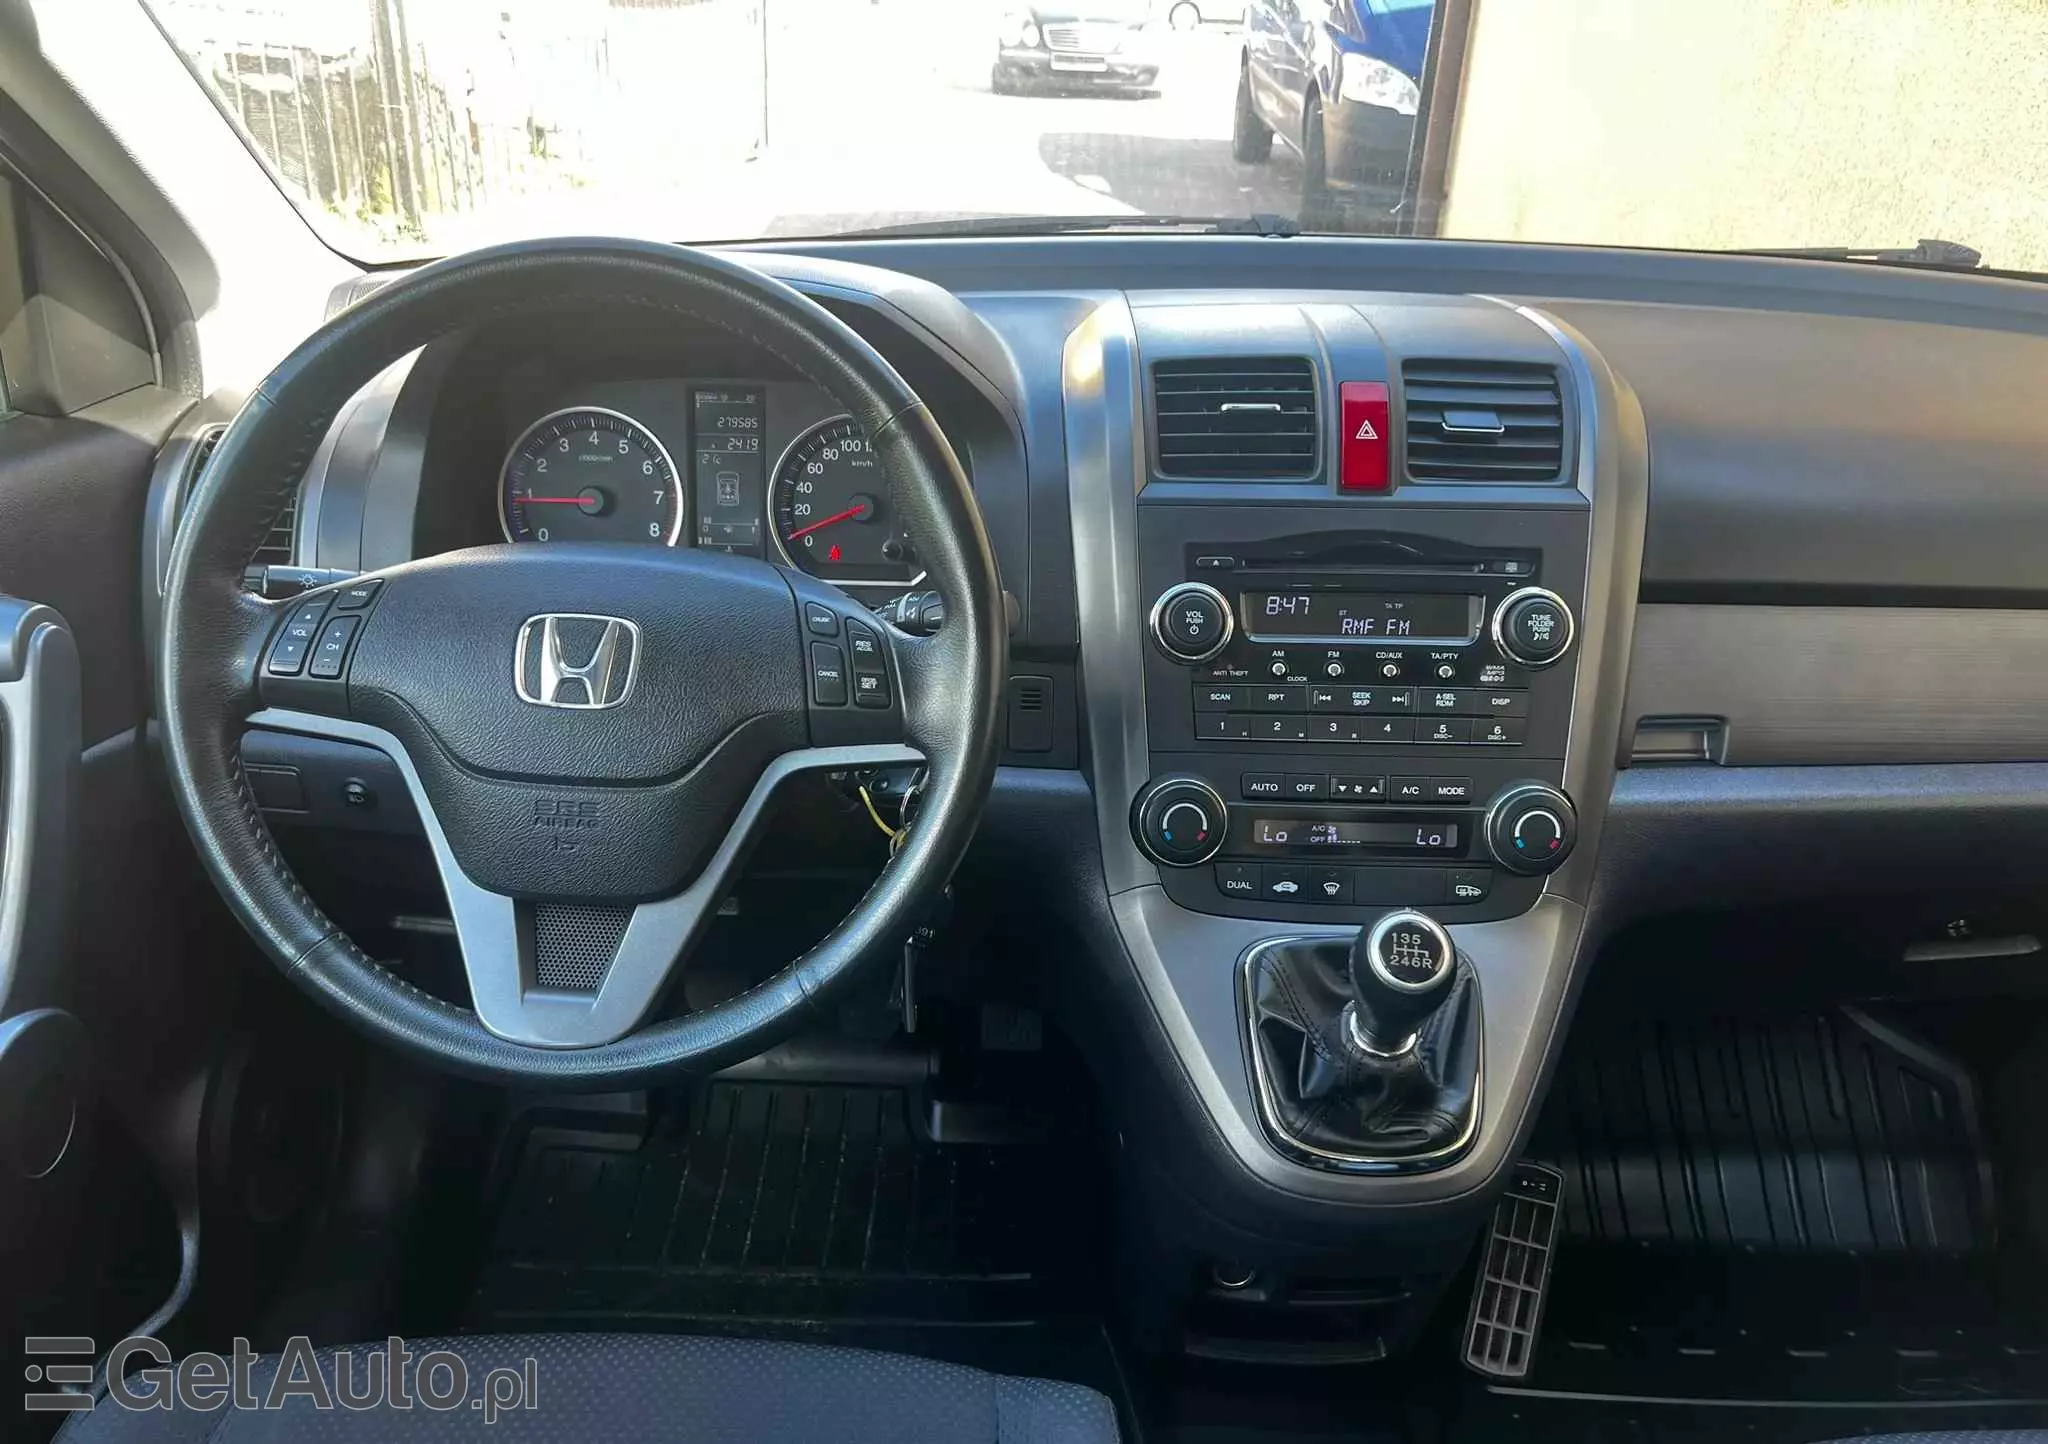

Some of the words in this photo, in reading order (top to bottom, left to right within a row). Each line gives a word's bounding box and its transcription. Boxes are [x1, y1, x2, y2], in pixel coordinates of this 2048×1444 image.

[588, 432, 599, 445] 4
[727, 438, 759, 450] 2419
[559, 439, 569, 452] 3
[618, 440, 629, 454] 5
[840, 439, 861, 452] 100
[822, 448, 839, 461] 80
[537, 459, 547, 472] 2
[642, 461, 653, 475] 6
[807, 462, 824, 475] 60
[796, 482, 813, 494] 40
[653, 490, 664, 505] 7
[794, 503, 811, 516] 20
[538, 528, 549, 542] 0
[650, 523, 660, 537] 8
[804, 535, 813, 547] 0
[1266, 596, 1310, 615] 8:47
[1341, 618, 1374, 635] RMF
[1386, 619, 1411, 635] FM
[292, 629, 308, 637] VOL
[1375, 651, 1403, 659] CD/AUX
[1220, 722, 1225, 730] 1
[1274, 722, 1281, 731] 2
[1329, 722, 1337, 732] 3
[1383, 724, 1391, 732] 4
[1439, 725, 1447, 733] 5
[1494, 726, 1501, 734] 6
[1251, 783, 1278, 791] AUTO
[1296, 784, 1316, 792] OFF
[1402, 786, 1420, 794] A/C
[1438, 787, 1465, 795] MODE
[1263, 825, 1288, 842] Lo
[1416, 828, 1441, 845] Lo
[1227, 880, 1253, 890] DUAL
